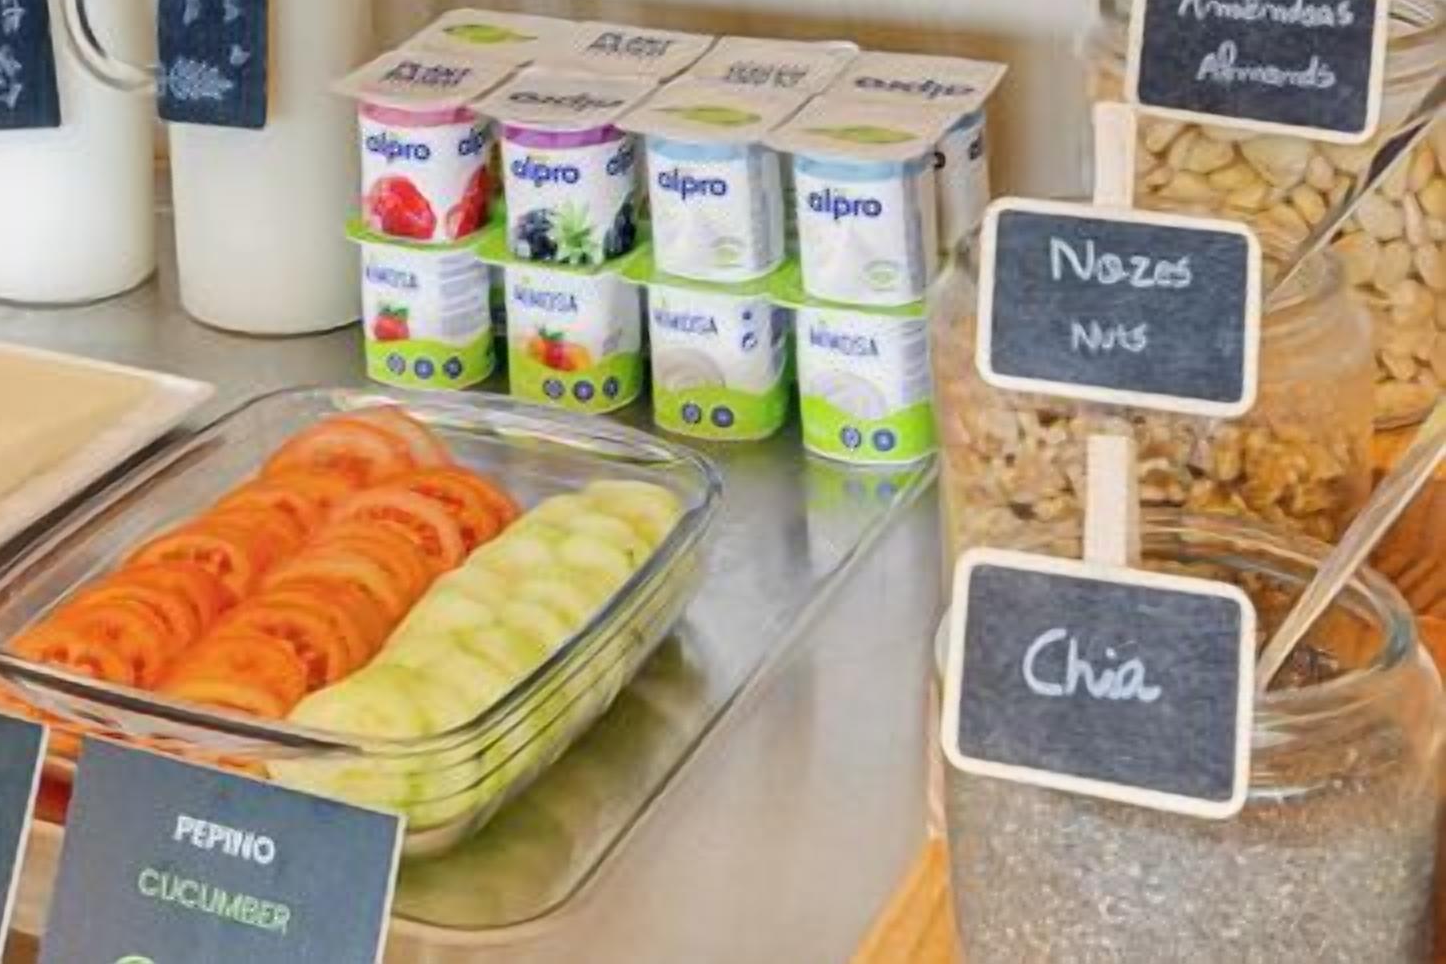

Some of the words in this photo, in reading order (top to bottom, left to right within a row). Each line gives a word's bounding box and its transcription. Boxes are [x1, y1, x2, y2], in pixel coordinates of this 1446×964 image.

[365, 131, 431, 163] alpro
[511, 155, 580, 188] alpro
[656, 167, 728, 201] alpro
[809, 189, 883, 220] alpro
[1022, 627, 1162, 702] Chia
[171, 814, 276, 865] PEPINO
[137, 867, 291, 935] CUCUMBER
